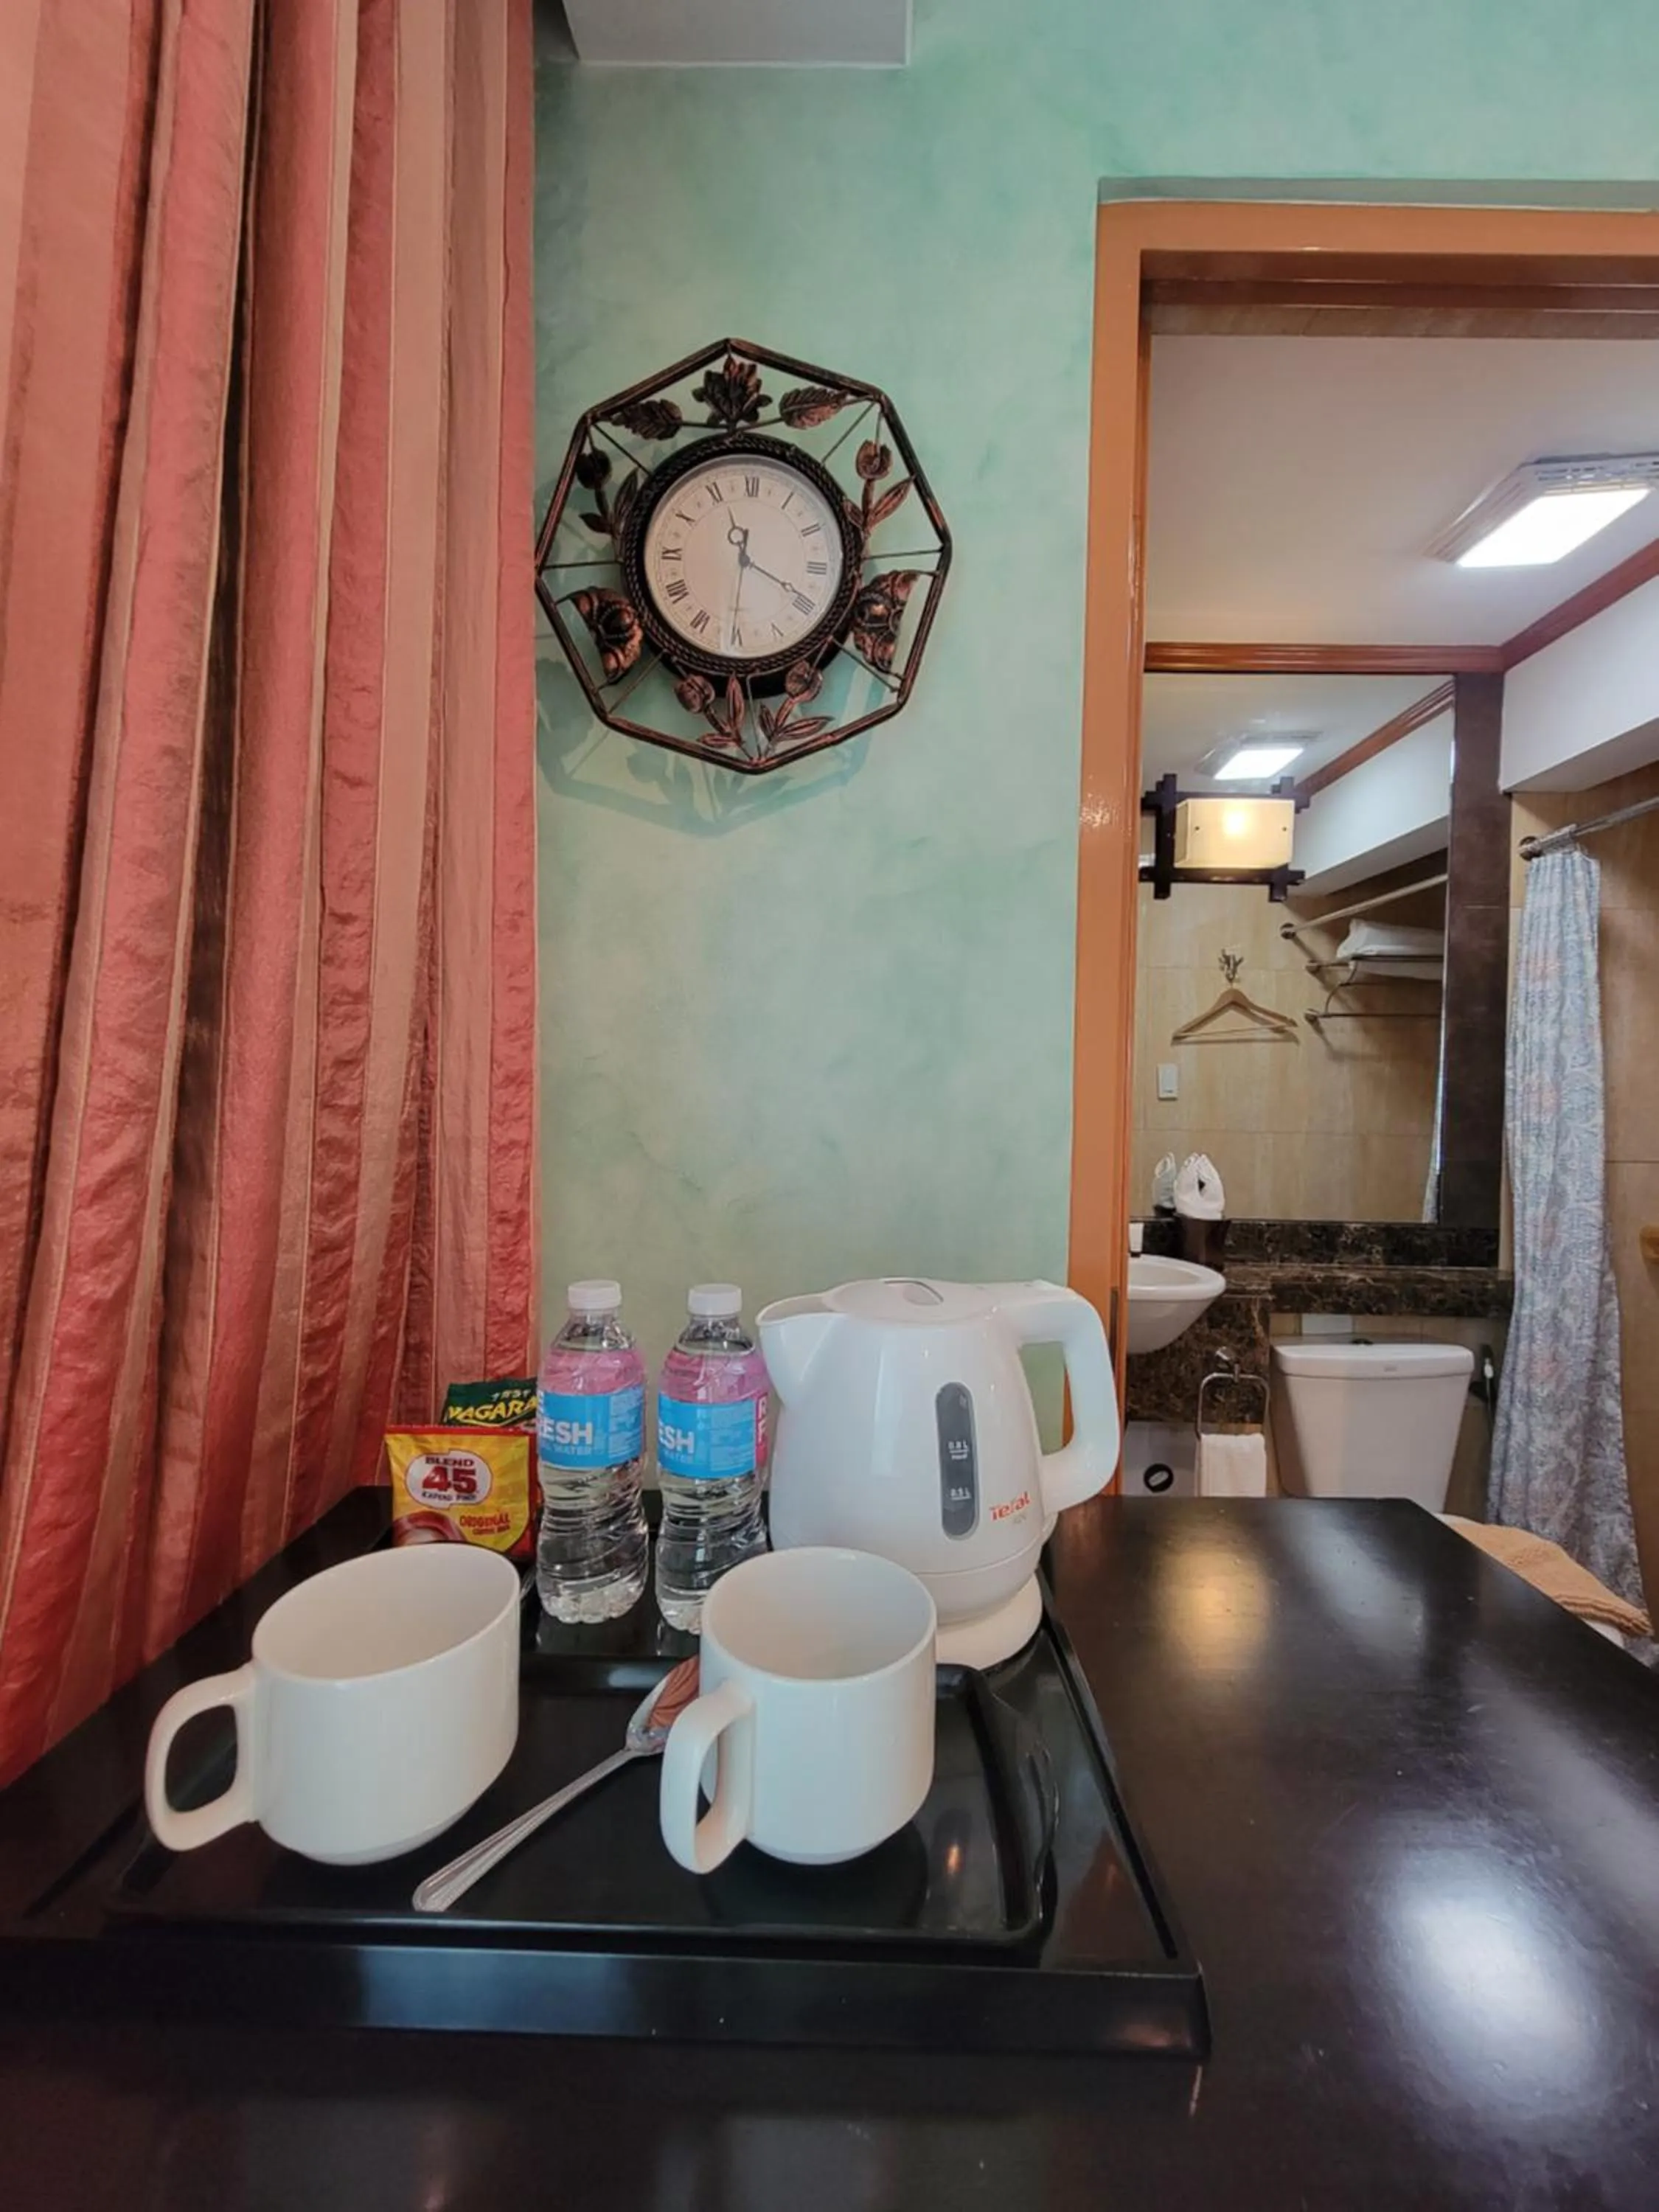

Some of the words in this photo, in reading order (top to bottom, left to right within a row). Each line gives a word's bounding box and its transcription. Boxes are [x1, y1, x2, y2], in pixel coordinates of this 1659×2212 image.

[801, 522, 821, 538] II
[806, 561, 827, 575] III
[425, 1456, 474, 1467] BLEND
[422, 1466, 478, 1494] 45
